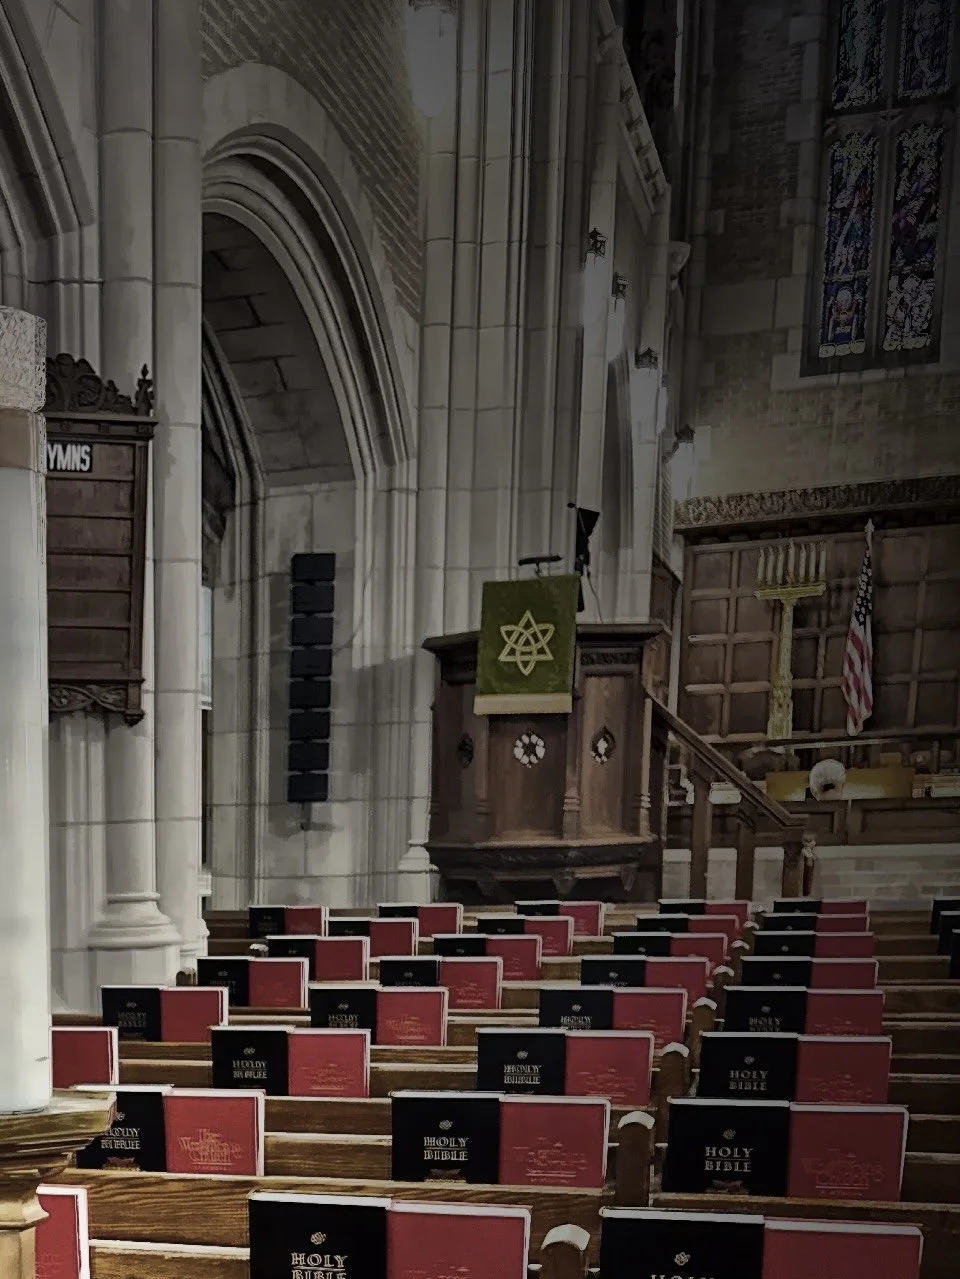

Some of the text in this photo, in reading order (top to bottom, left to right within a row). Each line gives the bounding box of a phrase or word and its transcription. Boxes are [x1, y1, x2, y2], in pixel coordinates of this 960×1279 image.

[47, 443, 91, 472] YMNS
[729, 1070, 769, 1080] HOLY
[729, 1081, 768, 1091] BIBLE
[423, 1136, 470, 1148] HOLY
[423, 1150, 469, 1161] BIBLE
[704, 1146, 754, 1158] HOLY
[704, 1160, 753, 1173] BIBLE
[290, 1252, 349, 1268] HOLY
